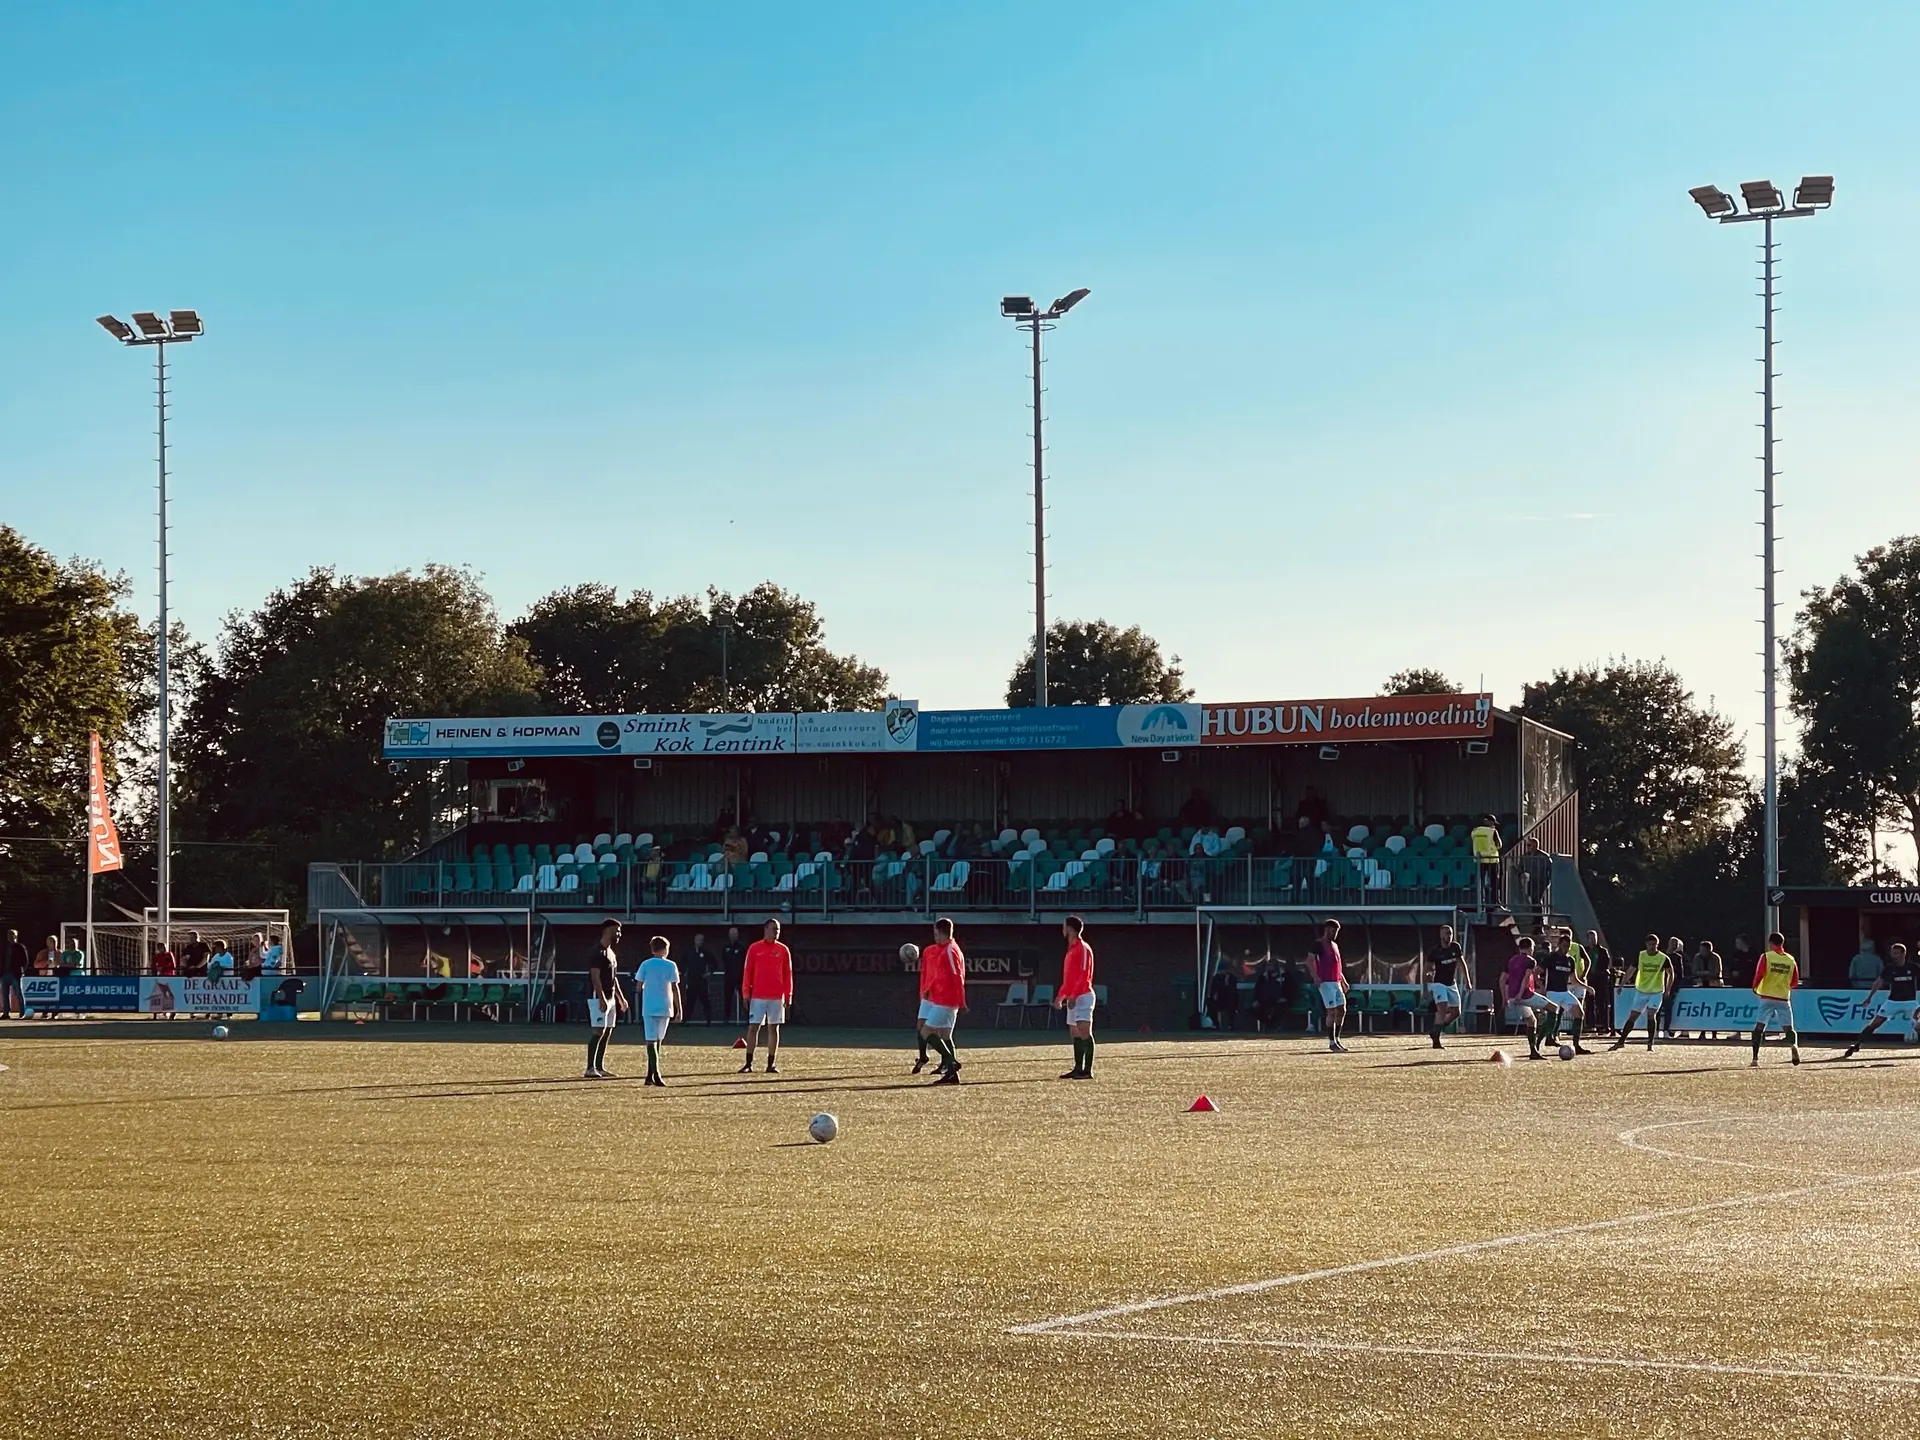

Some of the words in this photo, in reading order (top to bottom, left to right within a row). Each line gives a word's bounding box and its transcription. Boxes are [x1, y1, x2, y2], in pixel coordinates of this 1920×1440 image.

[623, 717, 692, 733] Smink
[757, 716, 798, 725] bedrijf
[1202, 705, 1324, 736] HUBUN
[1330, 703, 1488, 729] bodemvoeding
[436, 728, 491, 738] HEINEN
[497, 728, 507, 737] &
[513, 726, 580, 737] HOPMAN
[653, 737, 695, 752] Kok
[703, 735, 787, 752] Lentink
[1131, 735, 1149, 743] New
[1150, 734, 1165, 744] Day
[1166, 734, 1174, 742] at
[1870, 893, 1902, 903] CLUB
[26, 981, 58, 992] ABC
[62, 985, 138, 995] ABC-BANDEN.NL
[184, 979, 198, 990] DE
[184, 993, 251, 1005] VISHANDEL
[1675, 1001, 1712, 1018] Fish
